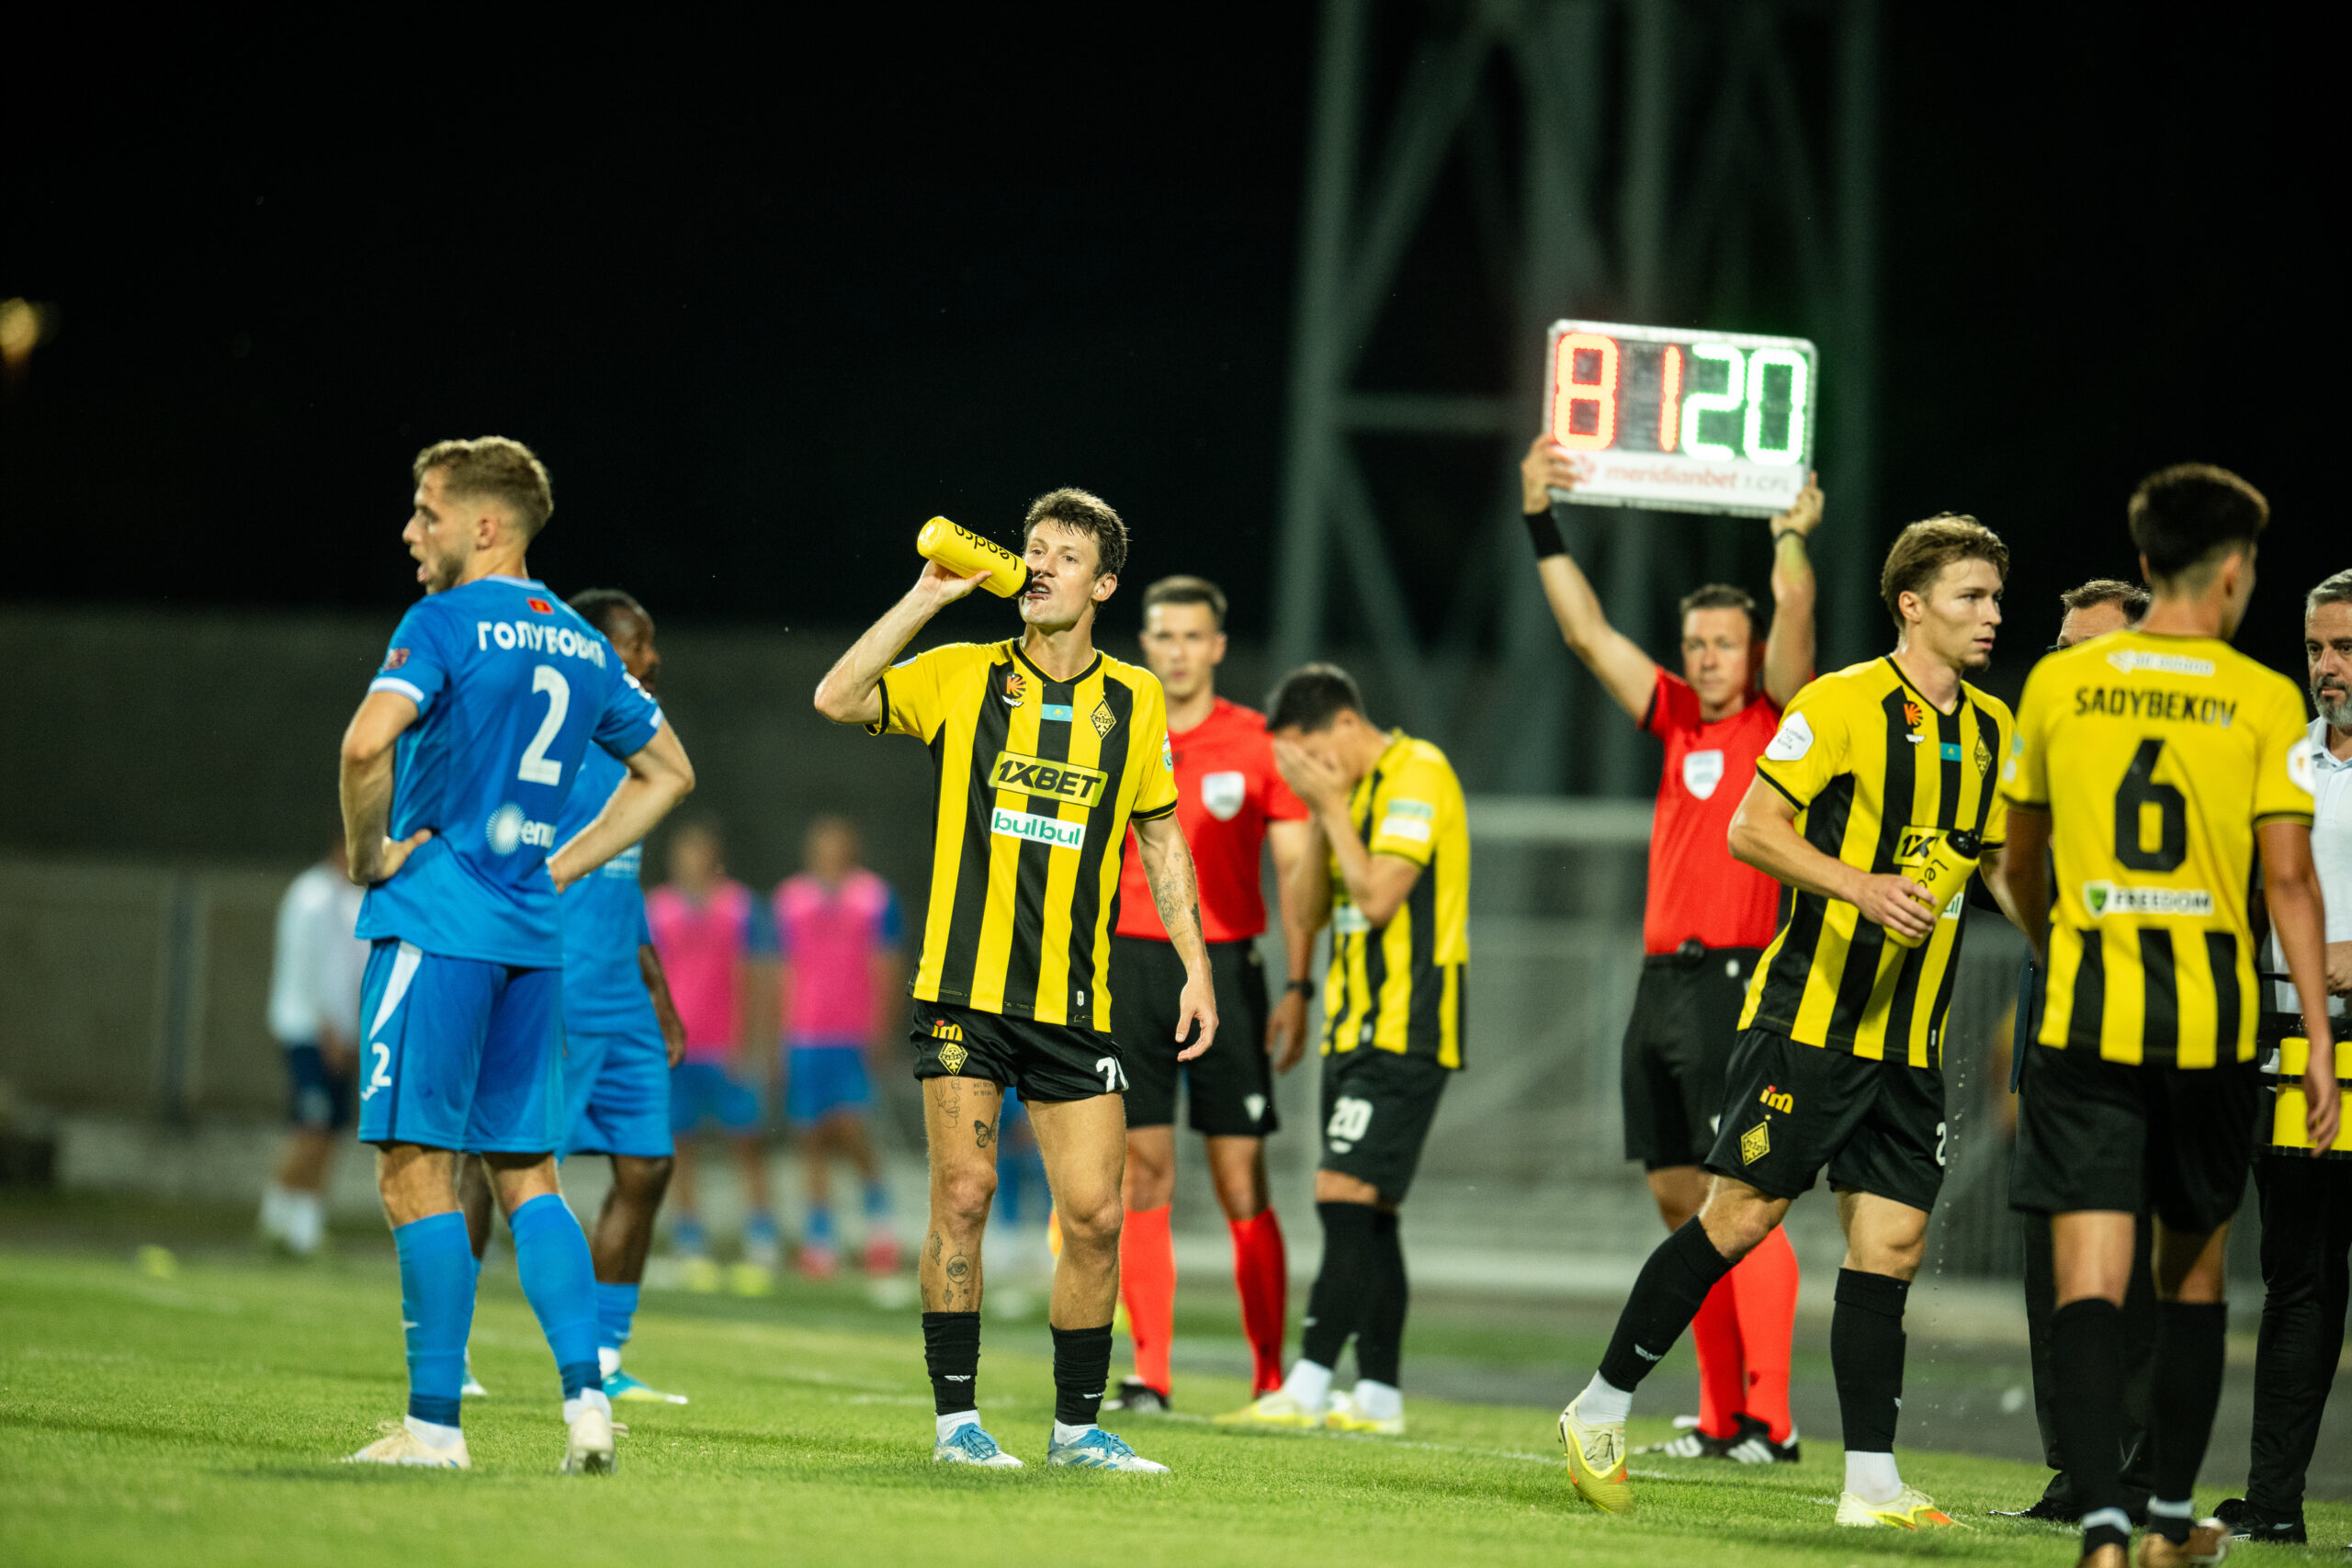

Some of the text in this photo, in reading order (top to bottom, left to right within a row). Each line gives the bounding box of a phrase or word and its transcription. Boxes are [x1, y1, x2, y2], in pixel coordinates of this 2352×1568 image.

[1680, 342, 1808, 465] 20
[517, 664, 570, 786] 2
[2075, 687, 2237, 728] SADYBEKOV
[998, 760, 1102, 798] 1XBET
[993, 811, 1081, 845] bulbul
[2114, 738, 2188, 874] 6
[2116, 891, 2211, 908] FREEDOM
[371, 1042, 392, 1087] 2
[1327, 1096, 1374, 1142] 20
